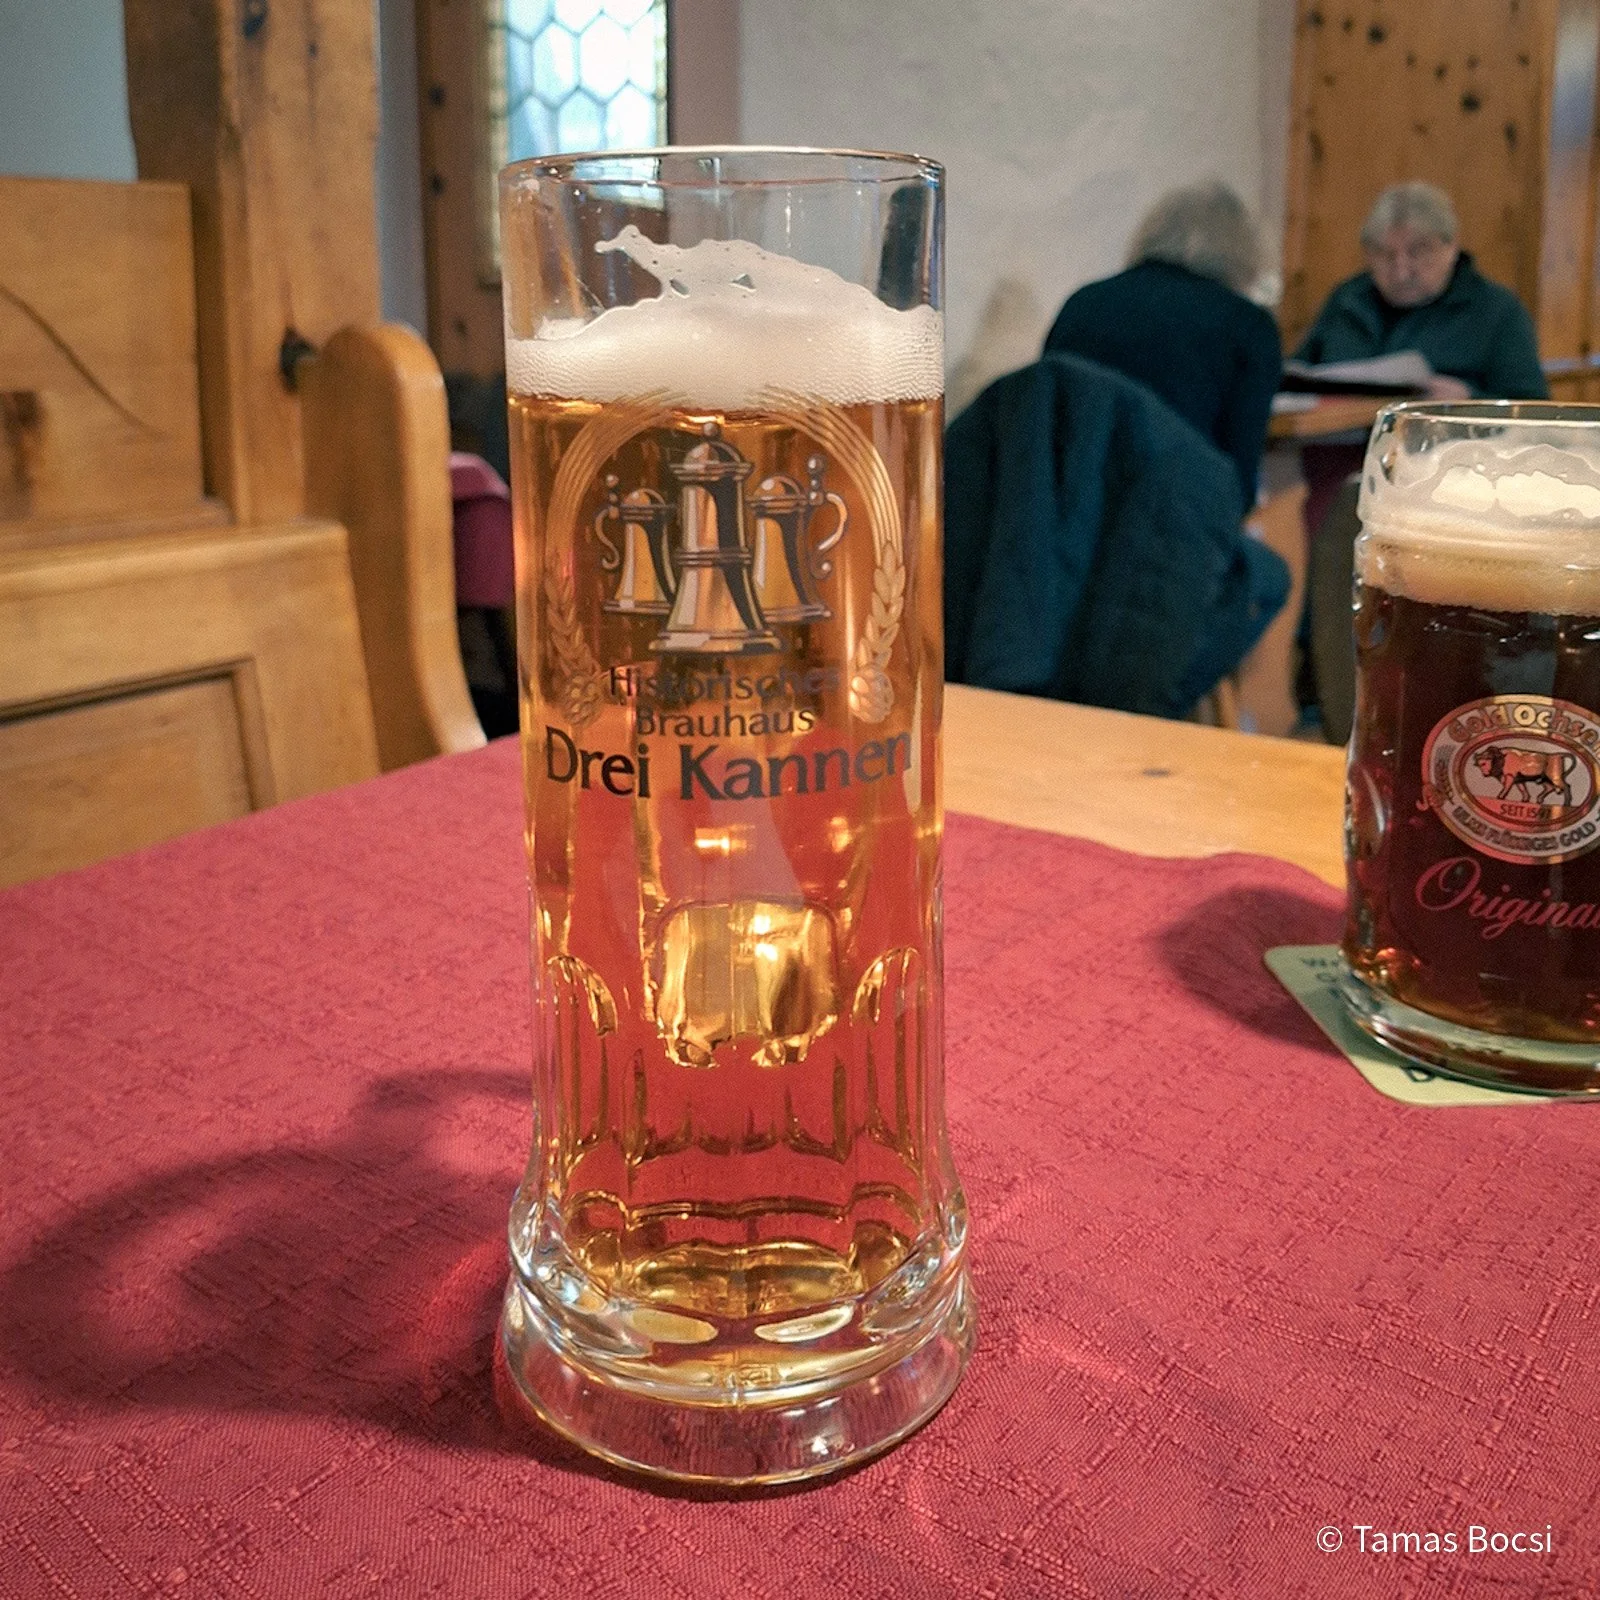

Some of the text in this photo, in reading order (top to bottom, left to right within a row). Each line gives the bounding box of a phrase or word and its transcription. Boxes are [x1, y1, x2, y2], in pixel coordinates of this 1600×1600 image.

[636, 703, 816, 737] Brauhaus
[1449, 704, 1509, 742] Gold
[546, 725, 912, 801] Drei Kannen
[1500, 803, 1525, 817] SEIT
[1559, 821, 1597, 847] GOLD
